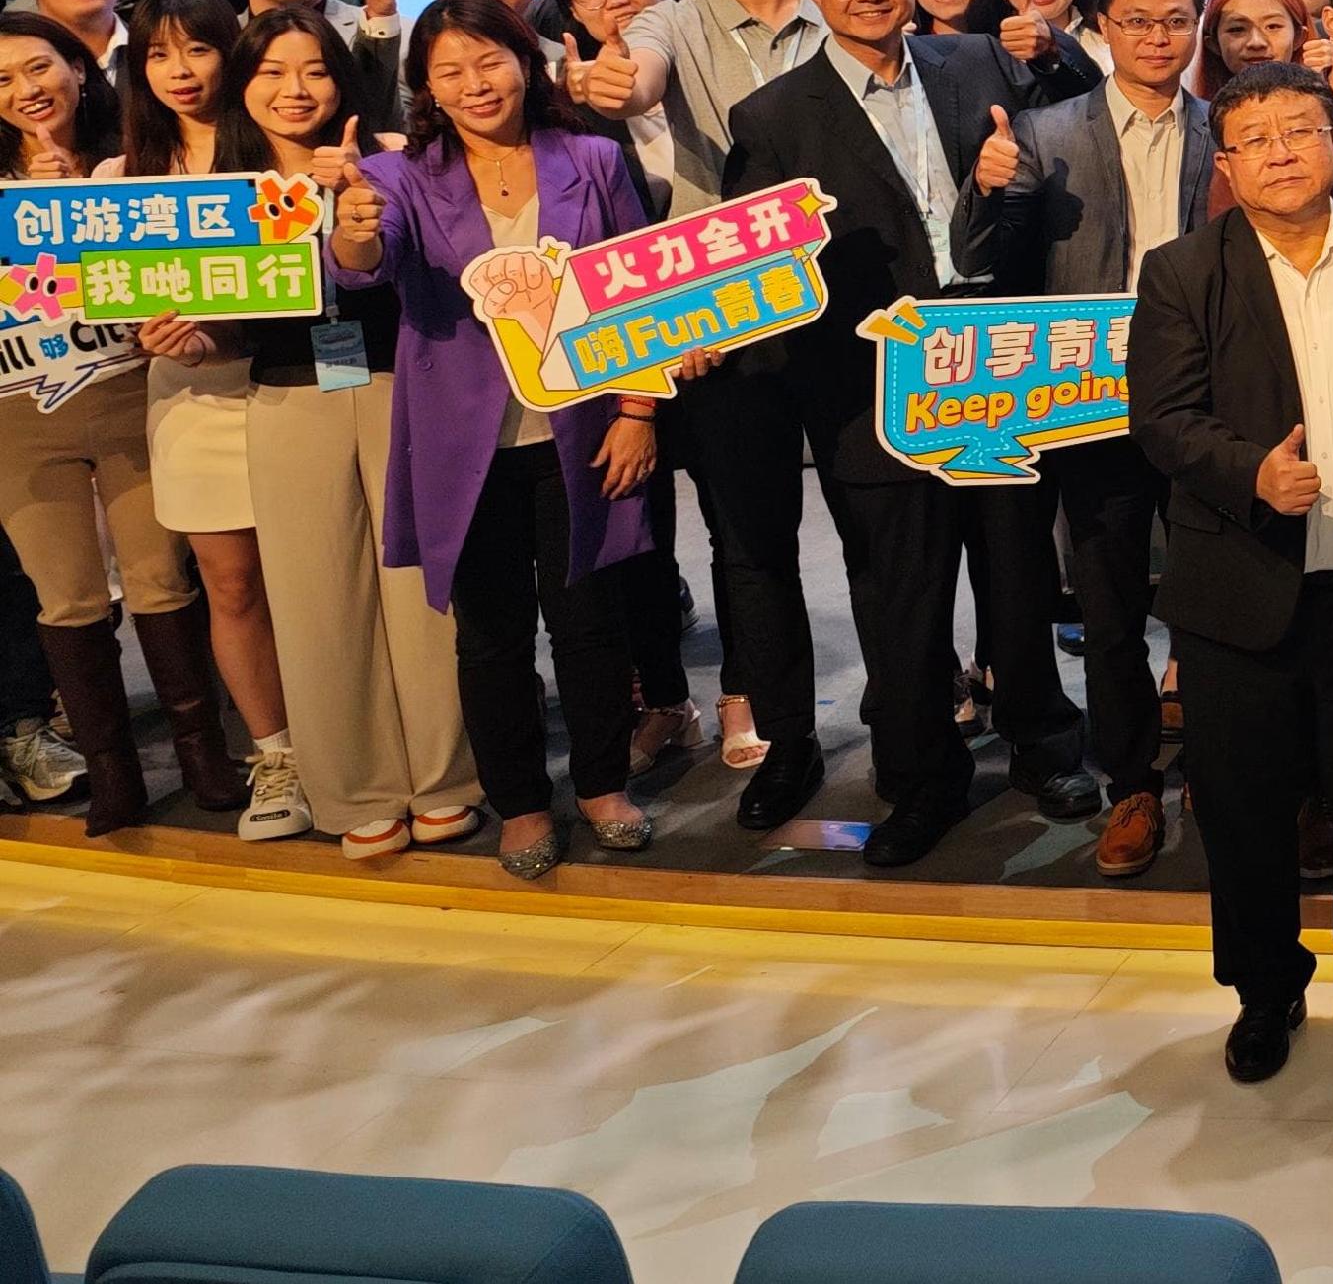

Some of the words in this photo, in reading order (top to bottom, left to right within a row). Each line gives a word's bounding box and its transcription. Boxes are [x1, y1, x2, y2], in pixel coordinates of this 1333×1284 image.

[14, 194, 235, 246] 创游湾区
[596, 197, 791, 300] 火力全开
[86, 254, 306, 305] 我哋同行
[70, 320, 140, 352] Cit
[573, 264, 805, 375] 嗨Fun青春
[905, 390, 1016, 434] Keep
